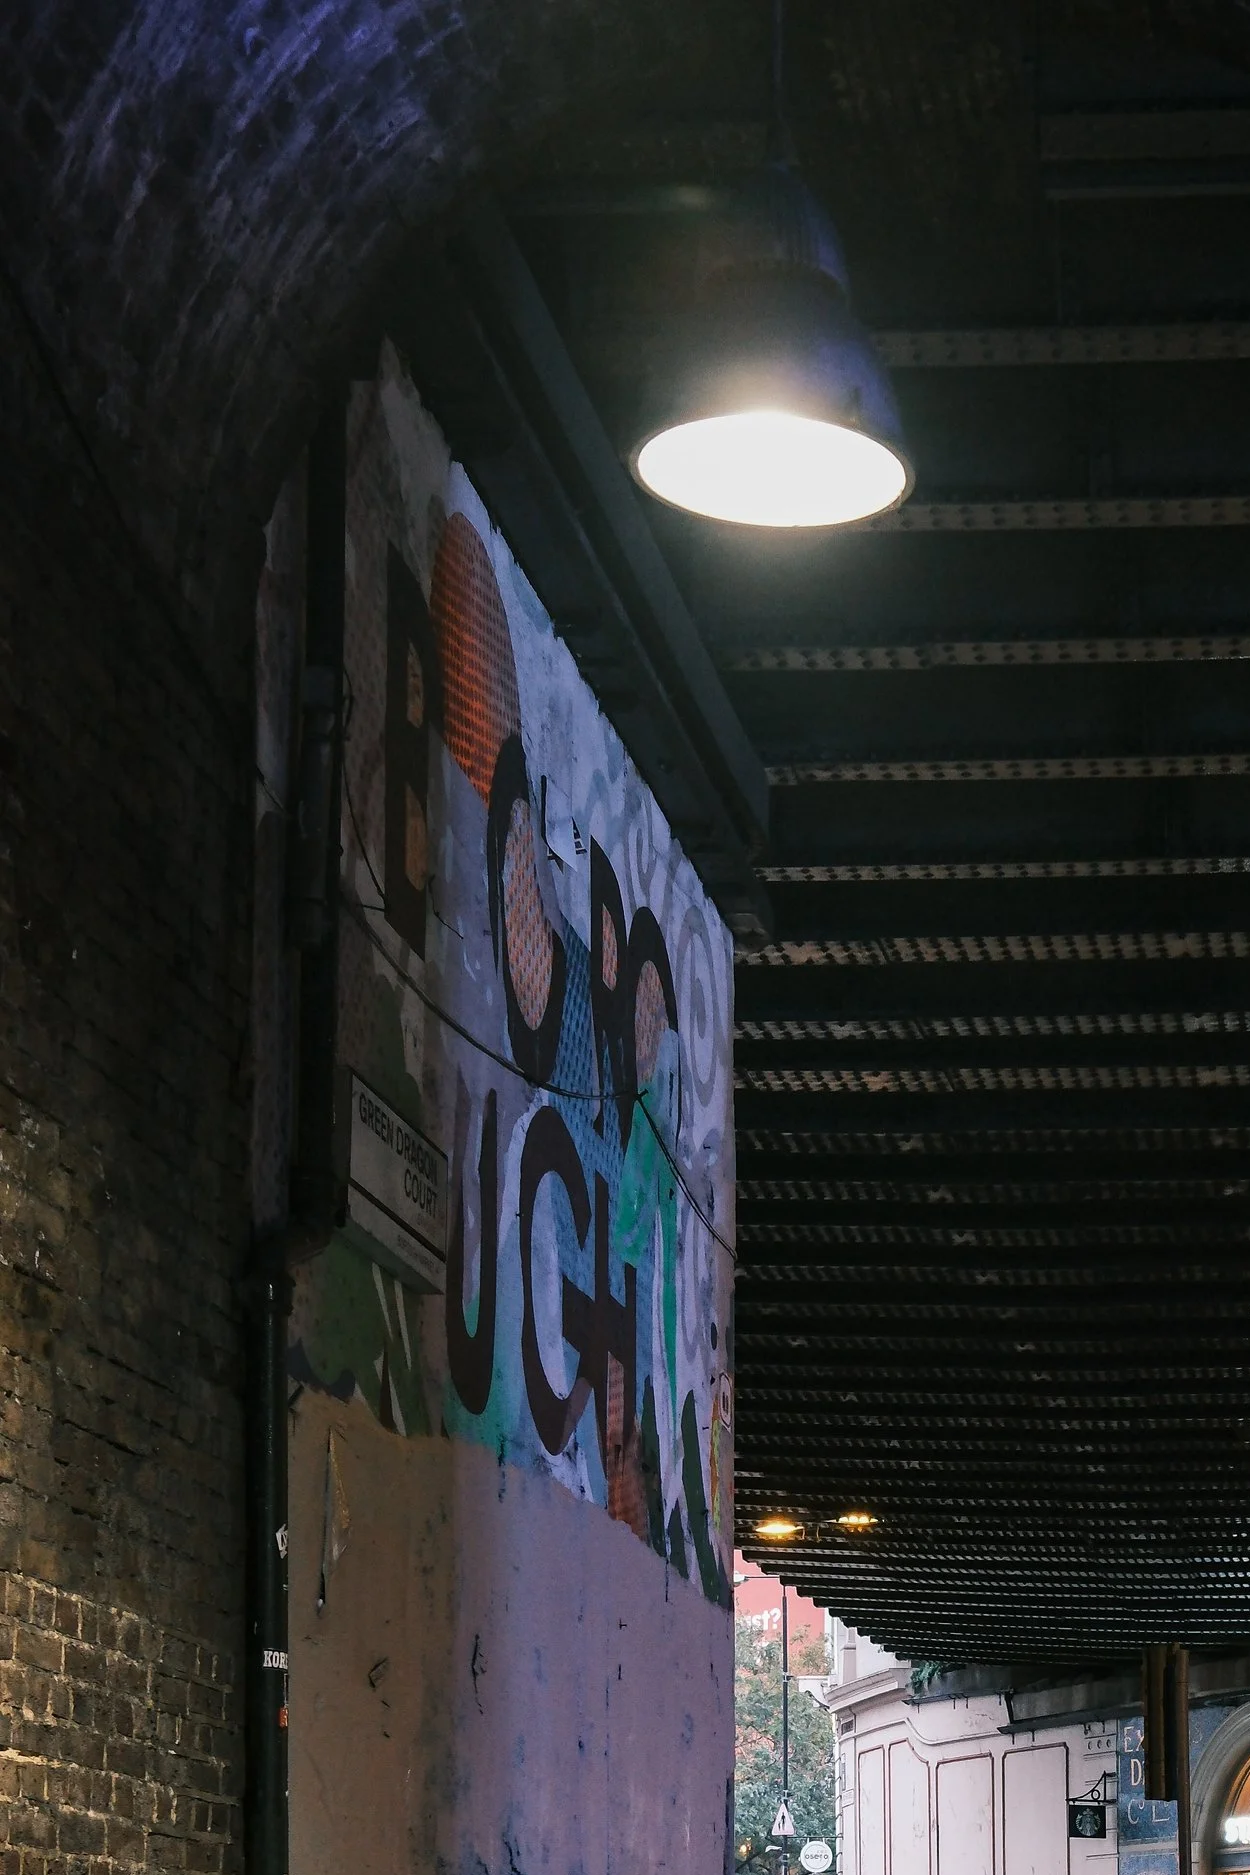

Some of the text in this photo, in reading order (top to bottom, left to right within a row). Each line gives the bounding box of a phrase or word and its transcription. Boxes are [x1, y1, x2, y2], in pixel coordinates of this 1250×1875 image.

[358, 1091, 438, 1186] GREEN DRAGON
[404, 1168, 438, 1218] COURT
